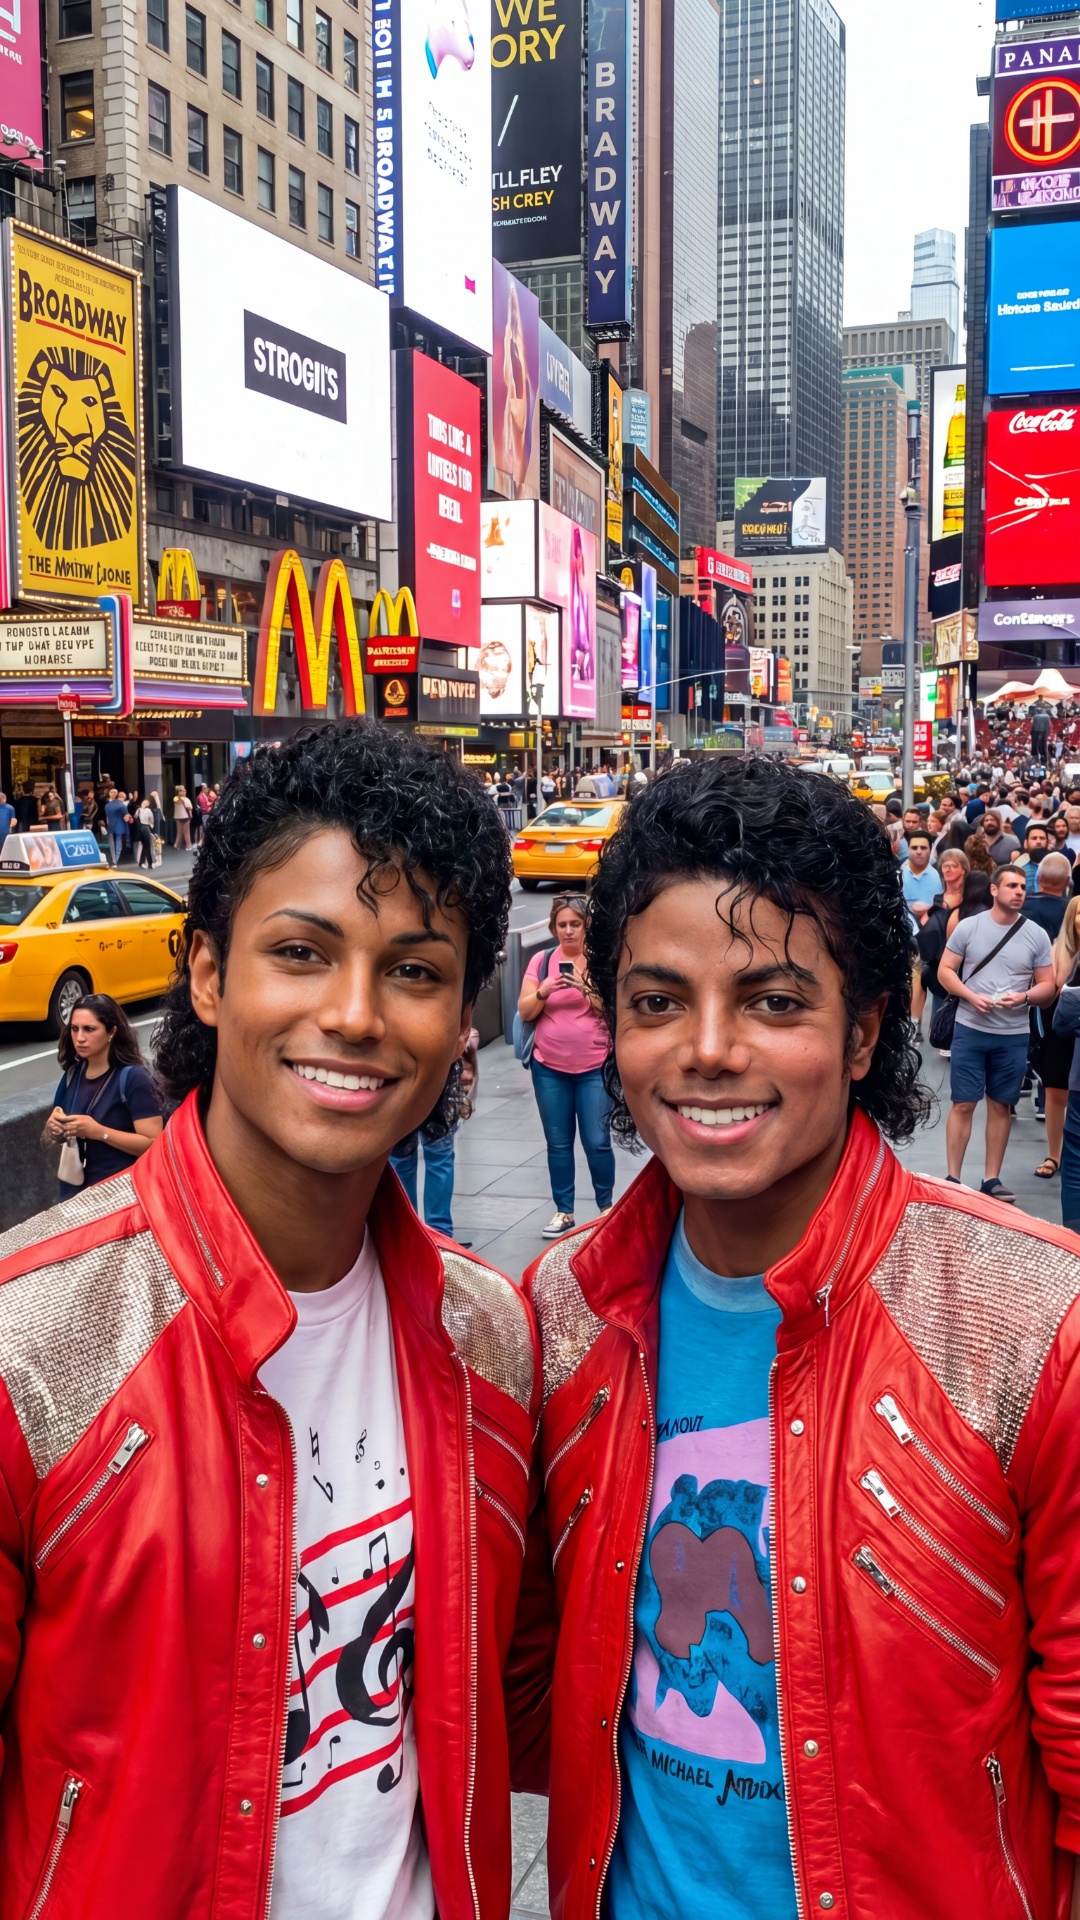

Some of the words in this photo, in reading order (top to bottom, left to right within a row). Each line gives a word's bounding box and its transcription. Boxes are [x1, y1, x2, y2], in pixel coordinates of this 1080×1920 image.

[1004, 45, 1080, 69] PANA
[590, 61, 622, 294] BRADWAY
[19, 268, 127, 345] BROADWAY
[28, 555, 51, 574] THE
[651, 1749, 714, 1789] MICHAEL
